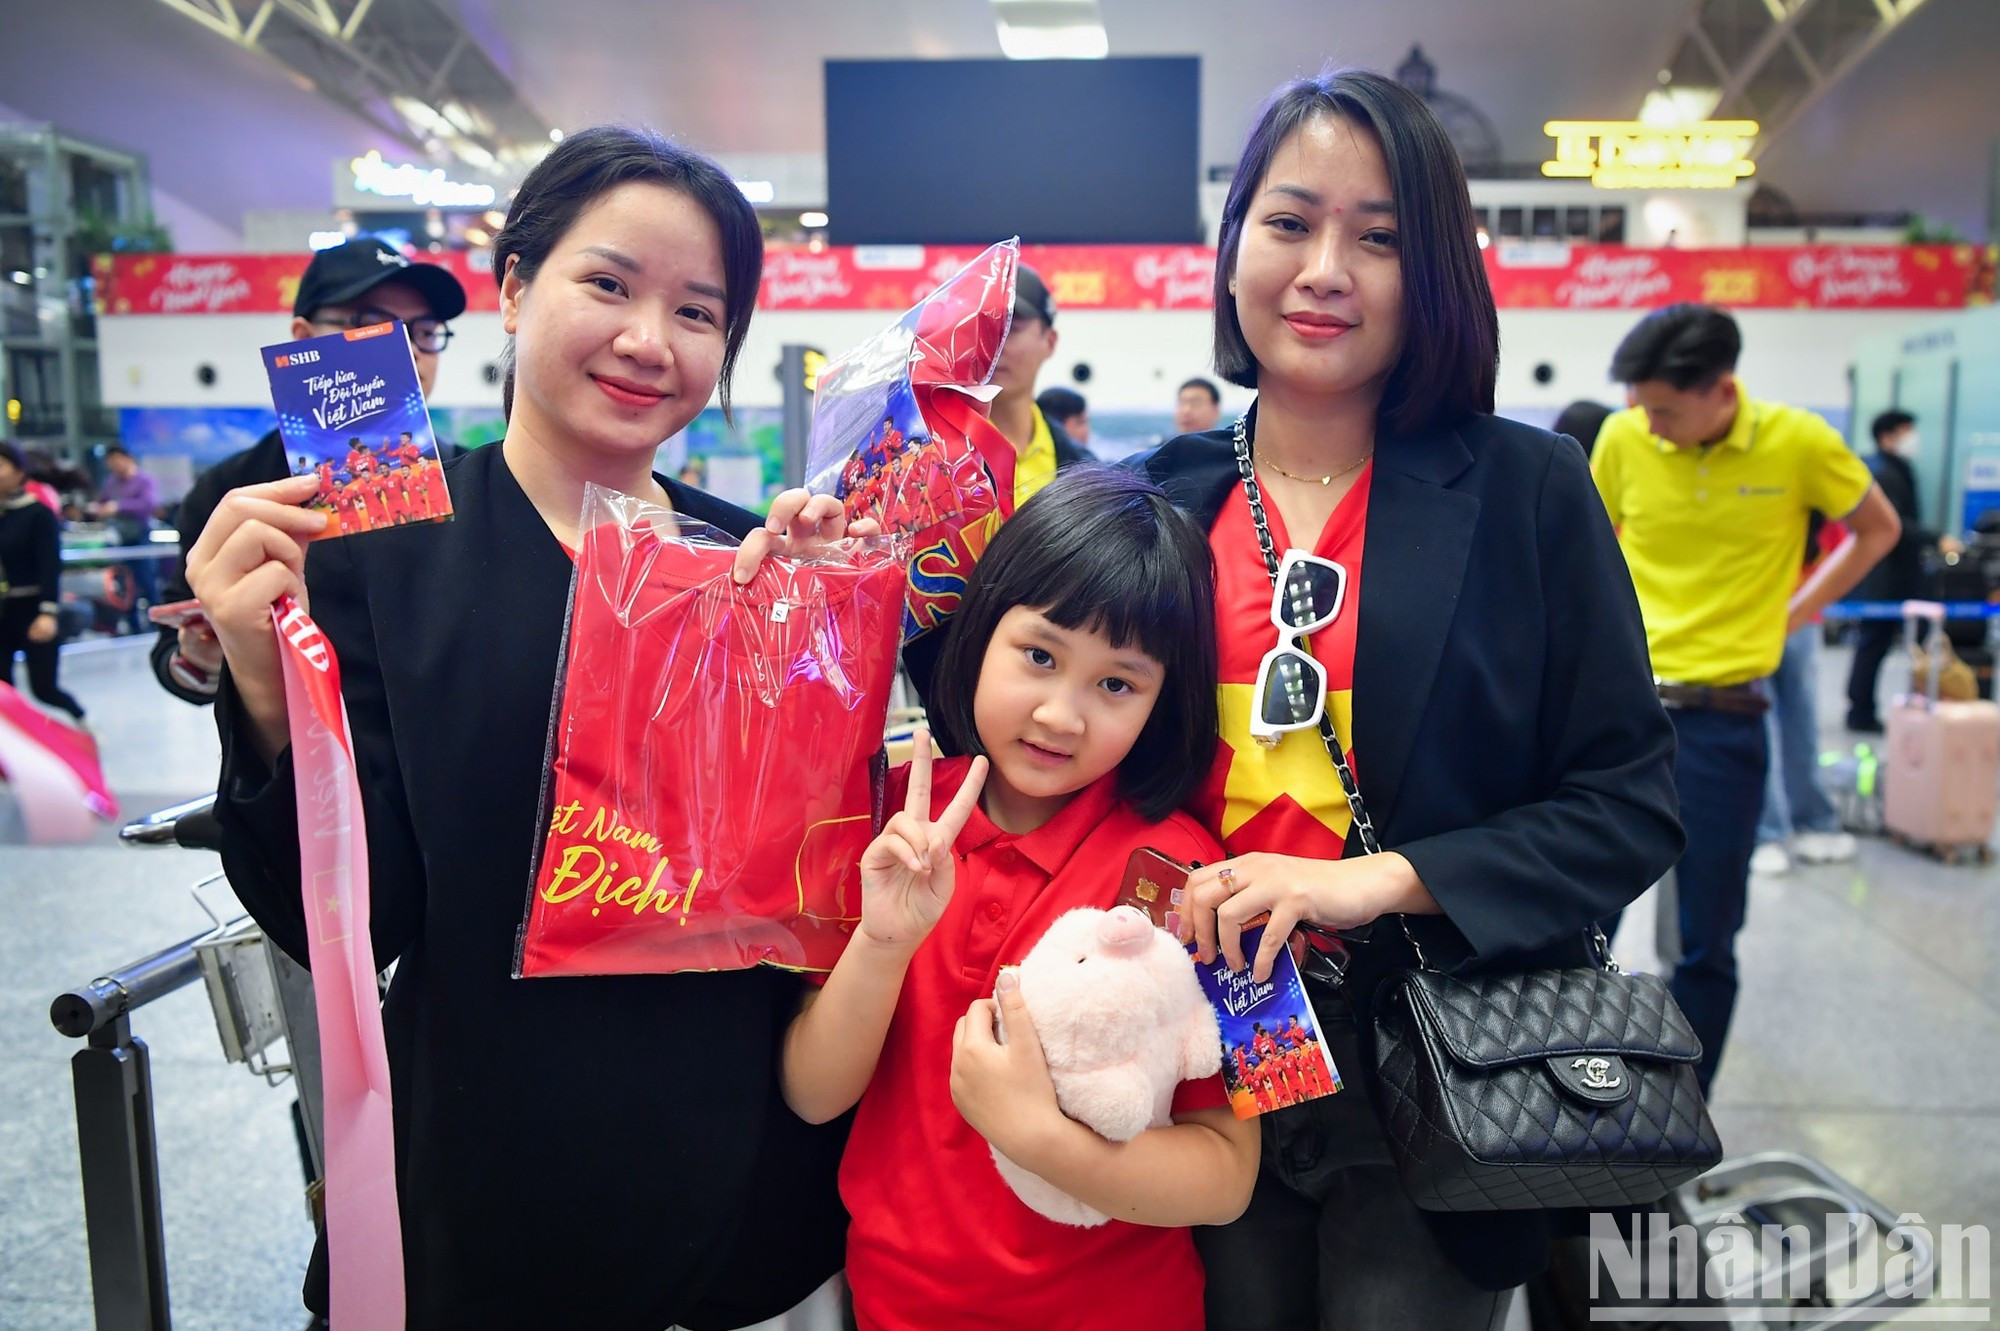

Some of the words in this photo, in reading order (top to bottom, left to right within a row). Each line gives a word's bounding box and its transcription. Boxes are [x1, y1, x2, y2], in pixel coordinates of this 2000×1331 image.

[289, 350, 320, 366] SHB
[303, 374, 334, 396] Tiếp
[329, 387, 351, 404] Đội
[351, 375, 385, 397] tuyển
[312, 397, 347, 430] Việt
[350, 396, 386, 418] Nam
[582, 806, 664, 853] Nam
[540, 845, 703, 926] Địch!
[1223, 987, 1249, 1017] Việt
[1249, 983, 1274, 1004] Nam
